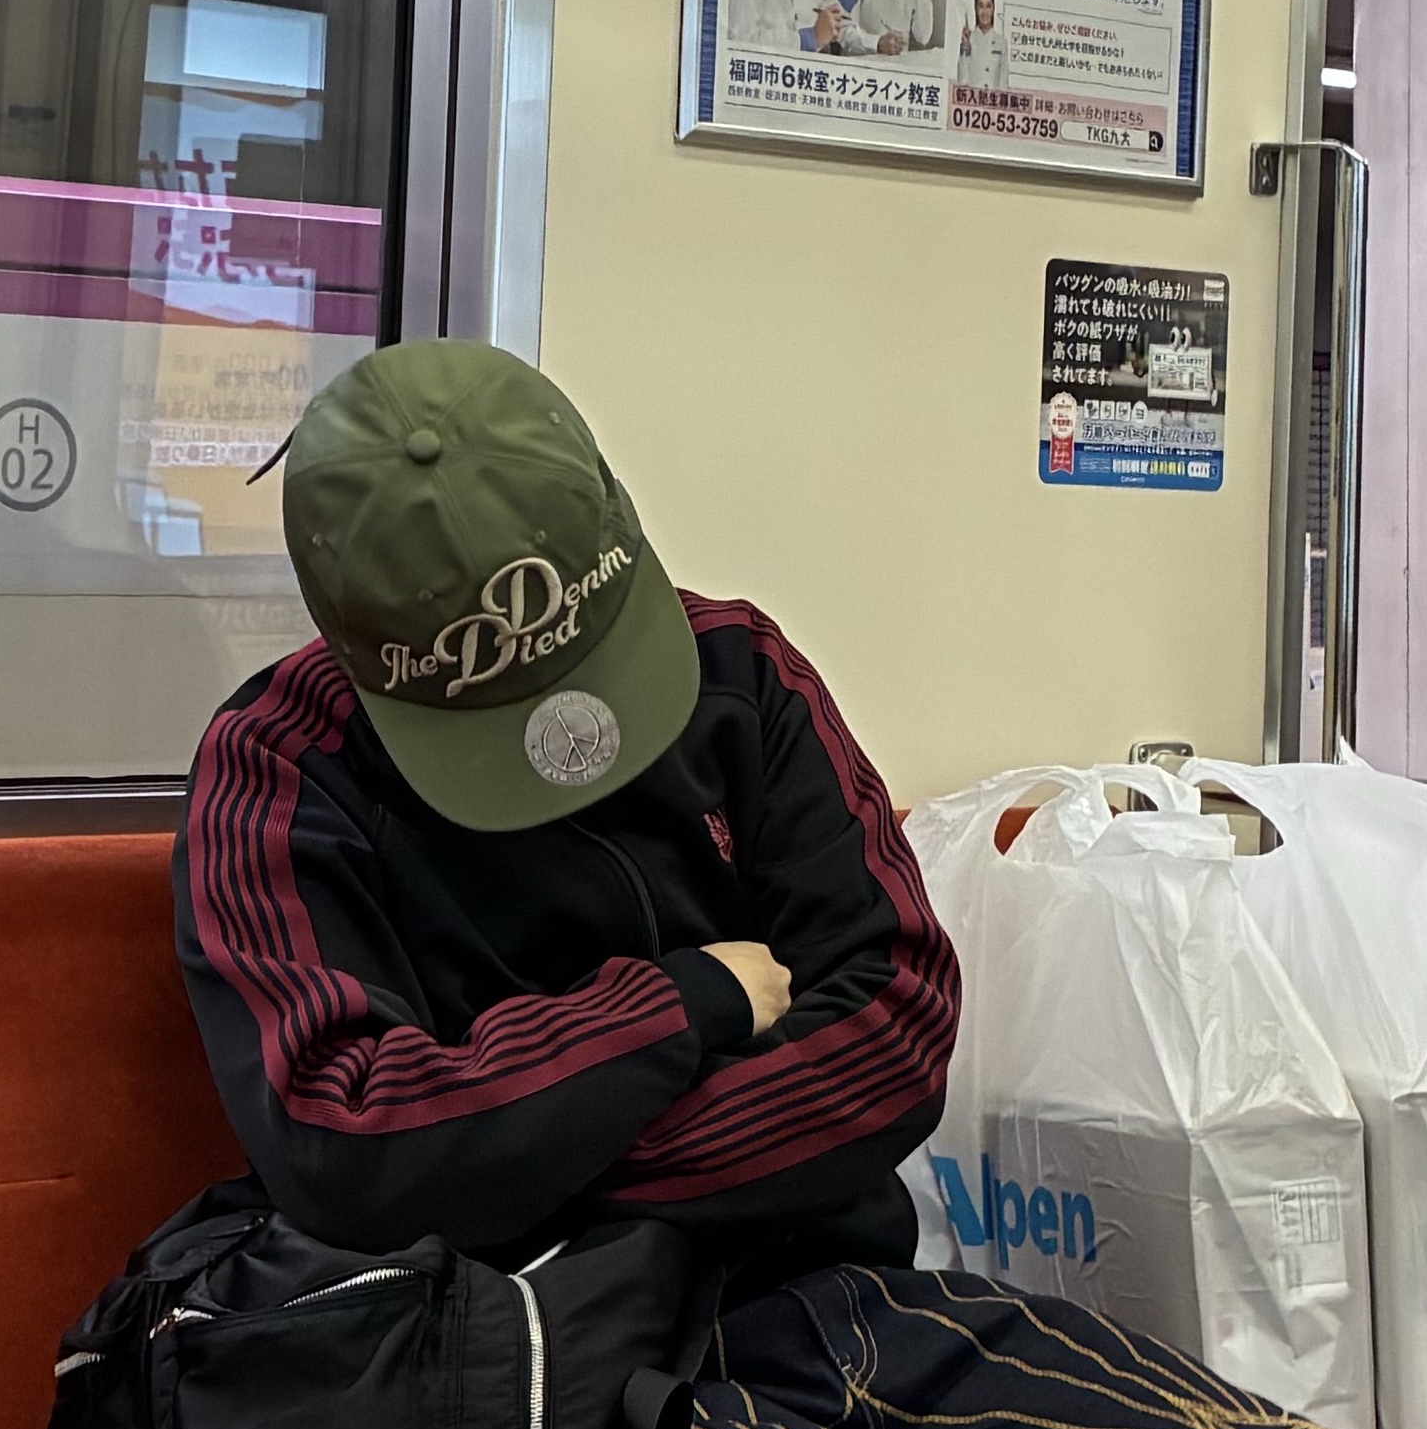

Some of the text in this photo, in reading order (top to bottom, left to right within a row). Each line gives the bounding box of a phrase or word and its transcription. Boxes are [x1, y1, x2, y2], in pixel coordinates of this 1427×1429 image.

[729, 58, 941, 108] 福岡市6教室・オンライン教室
[952, 107, 1059, 139] 0120-53-3759
[1086, 125, 1131, 147] TKG九大
[1052, 340, 1102, 363] 高く評価
[1051, 364, 1114, 387] されてます。
[16, 413, 41, 443] H
[0, 449, 55, 492] 02
[480, 544, 633, 643] Denim
[380, 605, 582, 699] The Died
